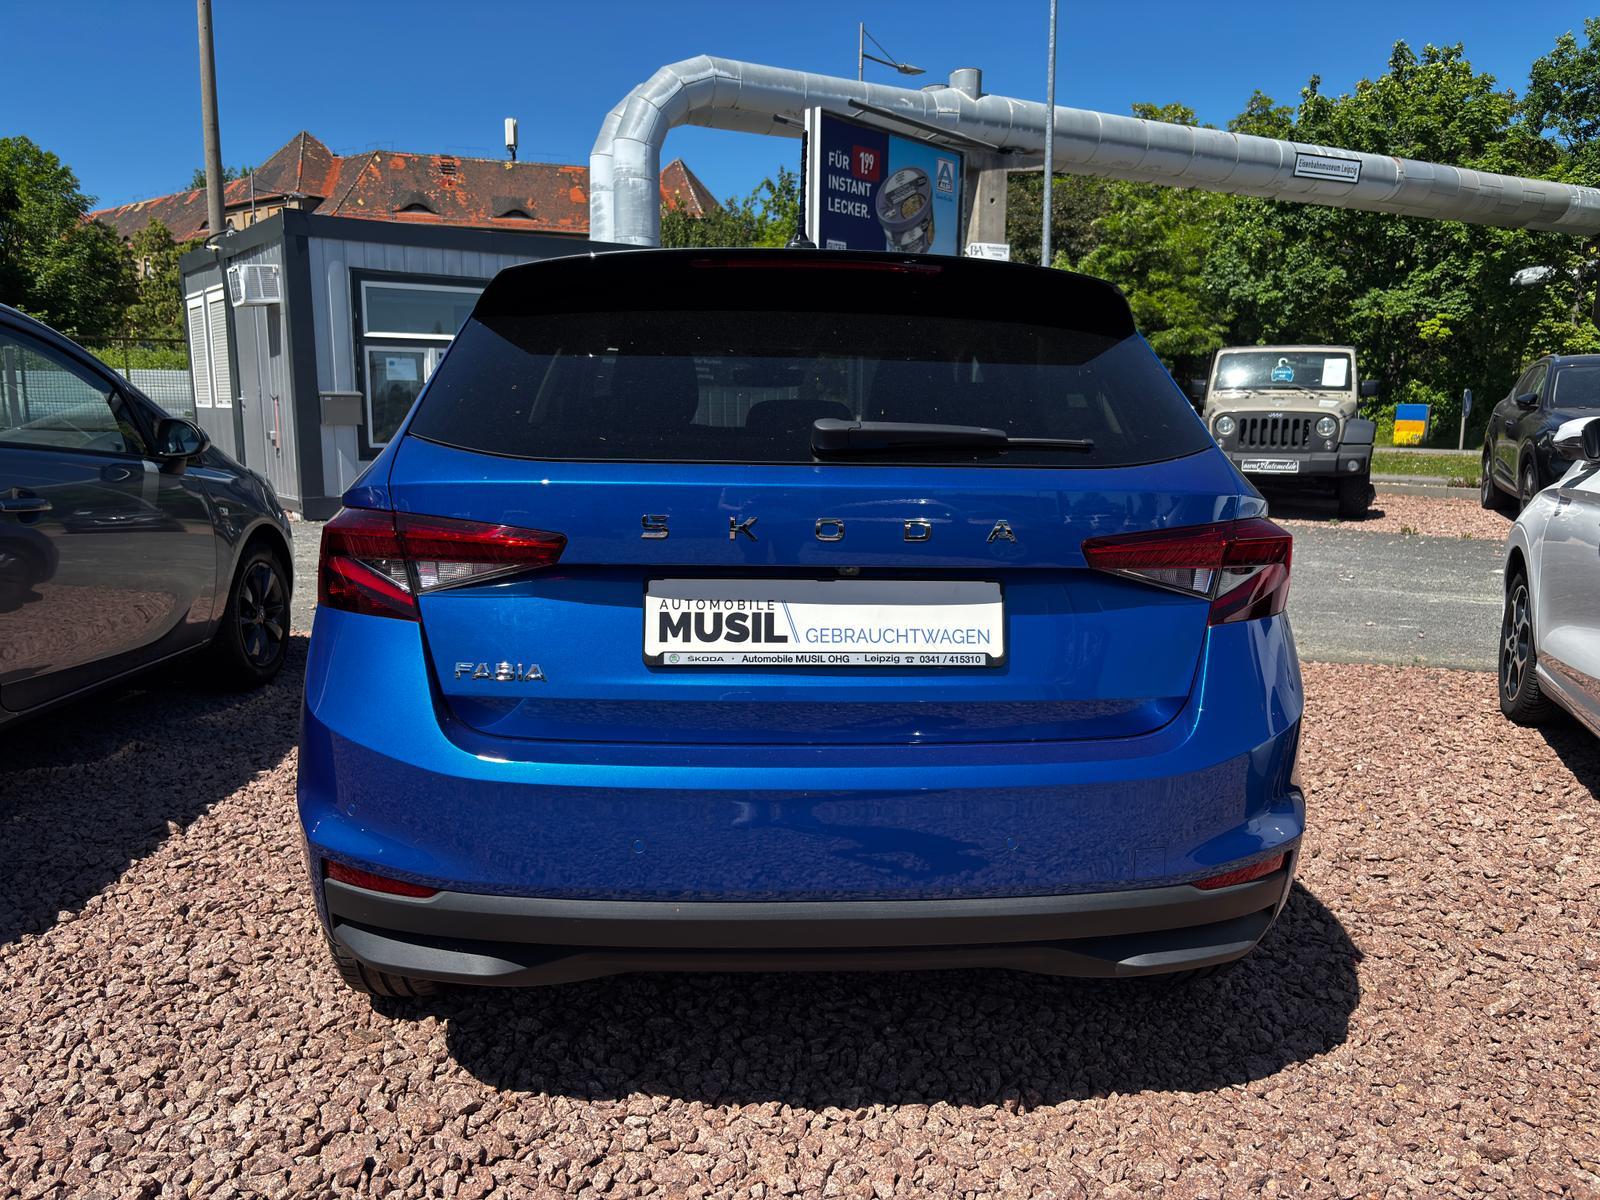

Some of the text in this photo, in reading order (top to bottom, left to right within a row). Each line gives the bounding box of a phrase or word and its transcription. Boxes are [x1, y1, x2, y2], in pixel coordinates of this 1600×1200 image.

[828, 150, 850, 170] FÜR
[1298, 158, 1358, 176] Eisenbahnmuseum Leipzig
[828, 174, 872, 197] INSTANT
[828, 196, 871, 219] LECKER.
[659, 599, 775, 611] AUTOMOBILE
[658, 612, 789, 643] MUSIL
[805, 627, 991, 644] GEBRAUCHTWAGEN
[741, 654, 793, 663] Automobile
[795, 654, 826, 663] MUSIL
[827, 654, 850, 664] OHG
[864, 654, 900, 664] Leipzig
[919, 655, 940, 664] 0341
[949, 655, 981, 664] 415310
[454, 661, 546, 681] FABIA
